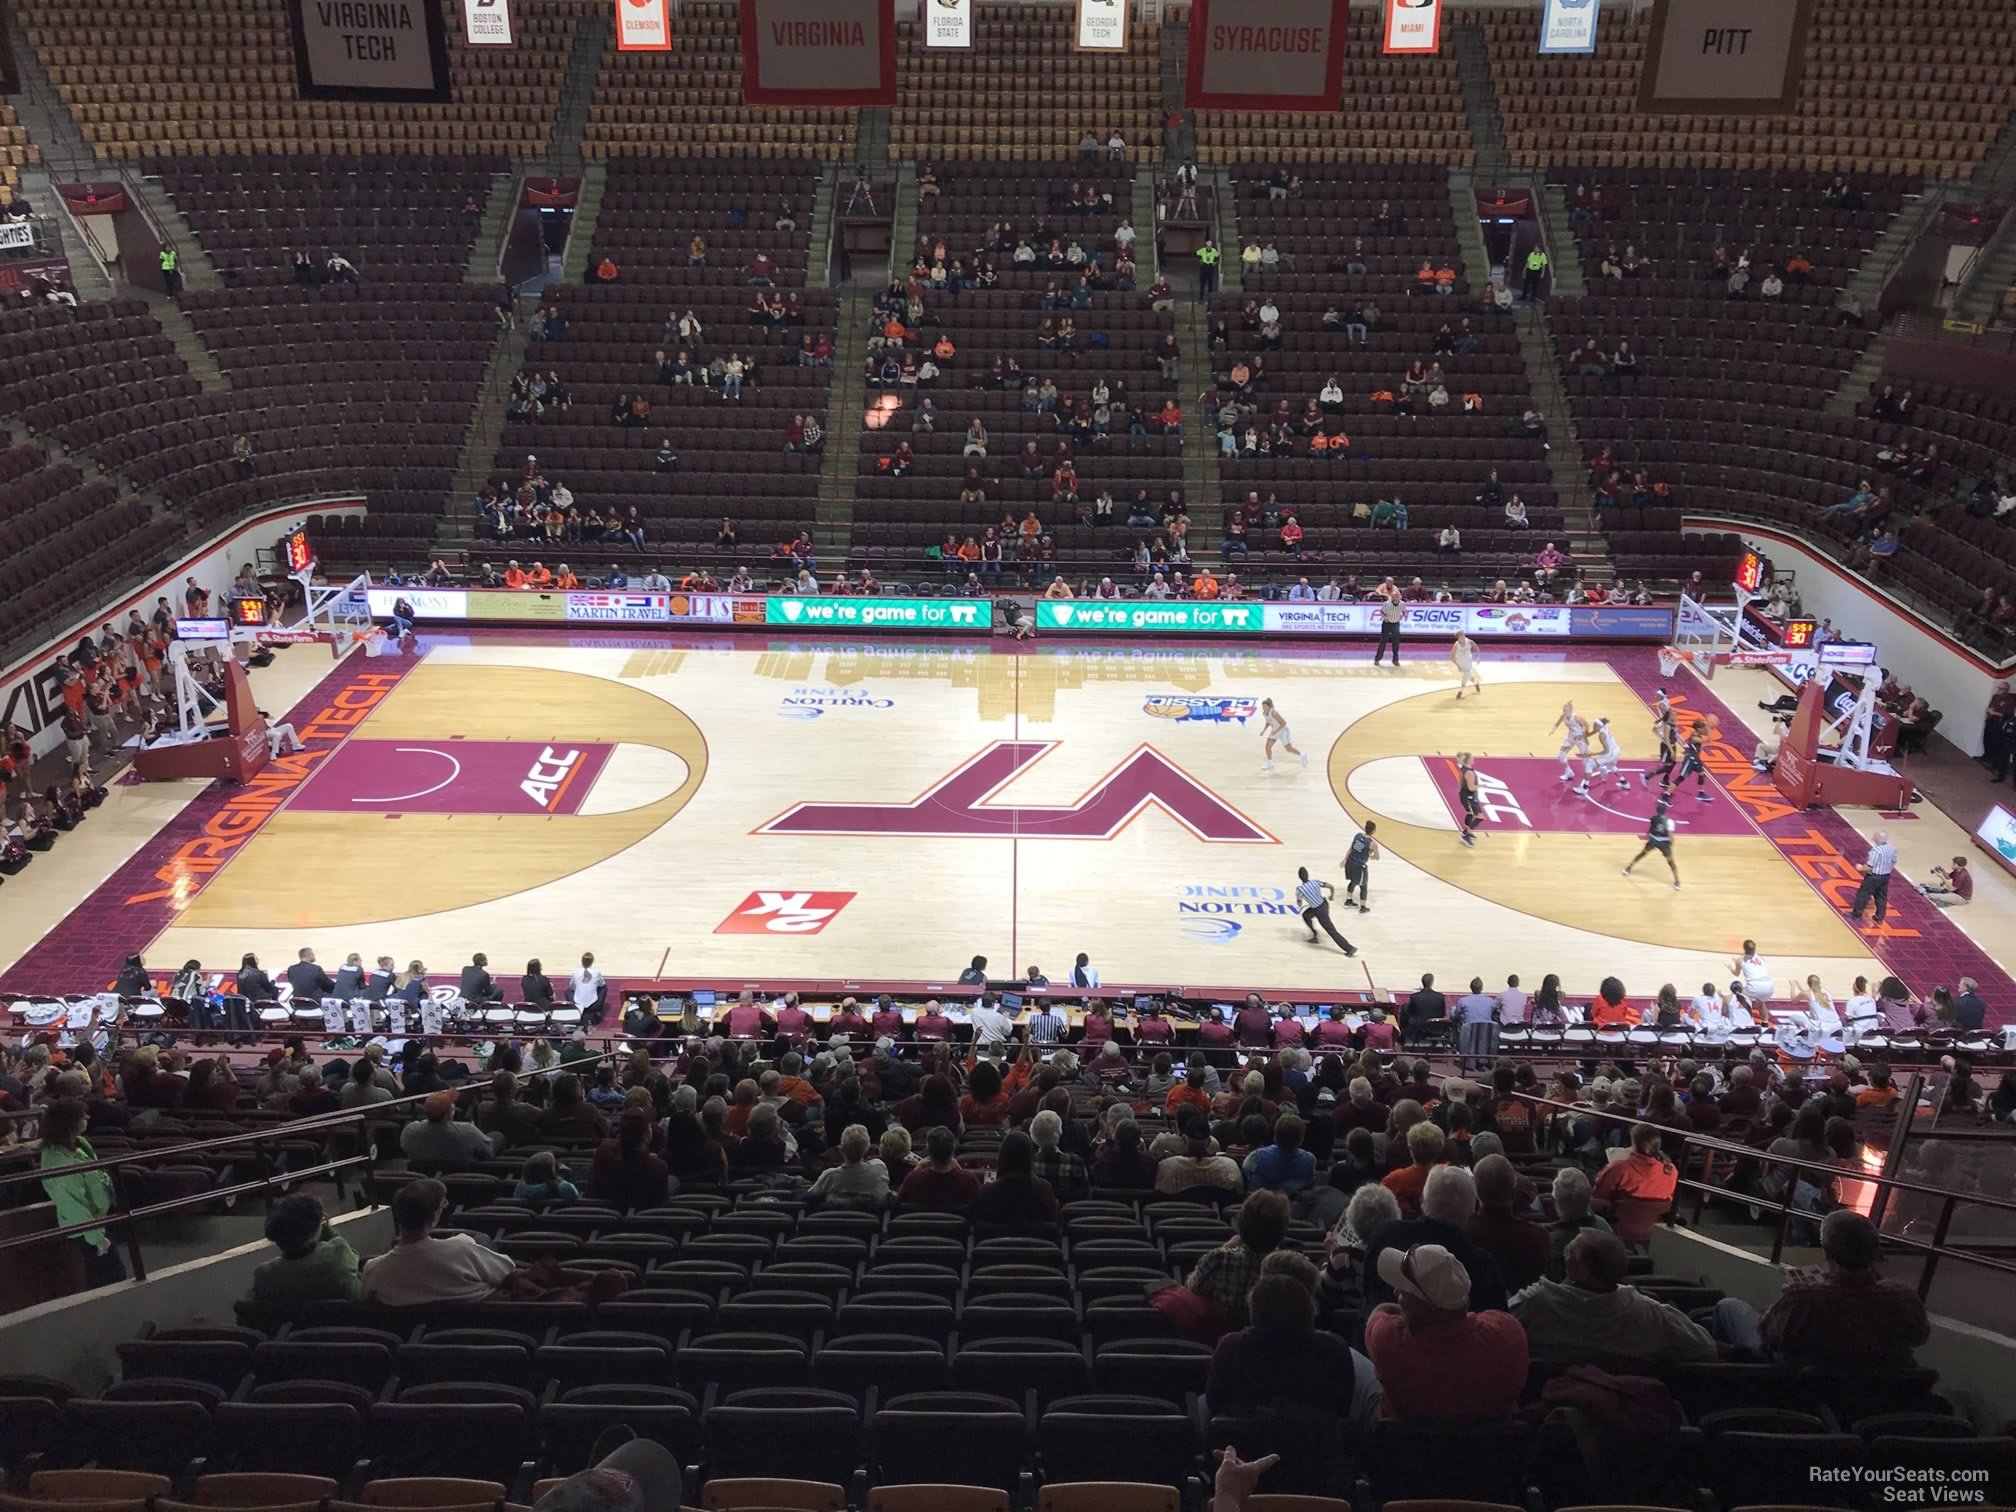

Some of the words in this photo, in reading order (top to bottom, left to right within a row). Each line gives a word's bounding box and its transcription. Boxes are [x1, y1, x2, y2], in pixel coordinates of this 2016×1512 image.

[317, 2, 412, 29] VIRGINIA
[473, 13, 502, 23] BOSTON
[933, 16, 963, 27] FLORIDA
[626, 20, 660, 30] CLEMSON
[1086, 17, 1117, 28] GEORGIA
[1400, 24, 1424, 33] MIAMI
[1556, 17, 1583, 28] NORTH
[473, 25, 504, 34] COLLEGE
[772, 21, 864, 47] VIRGINIA
[937, 27, 959, 38] STATE
[1092, 28, 1110, 38] TECH
[1550, 28, 1588, 39] CAROLINA
[1213, 26, 1323, 53] SYRACUSE
[1703, 28, 1752, 55] PITT
[342, 35, 396, 61] TECH
[570, 607, 617, 619] MARTIN
[621, 609, 665, 620] TRAVEL
[806, 603, 856, 619] we're
[862, 606, 917, 623] game
[922, 605, 946, 621] for
[950, 606, 977, 623] VT
[1076, 606, 1127, 623] we're
[1132, 609, 1187, 627] game
[1193, 608, 1218, 624] for
[1221, 608, 1249, 626] VT
[1279, 612, 1320, 621] VIRGINIA
[1326, 613, 1350, 622] TECH
[782, 697, 894, 708] CARILION
[1147, 697, 1256, 707] CLASSIC
[300, 674, 401, 744] TECH
[520, 745, 580, 808] ACC
[125, 750, 330, 904] VIRGINIA
[1176, 885, 1285, 901] CLINIC
[741, 892, 837, 932] 2K
[1178, 901, 1309, 915] ARILION
